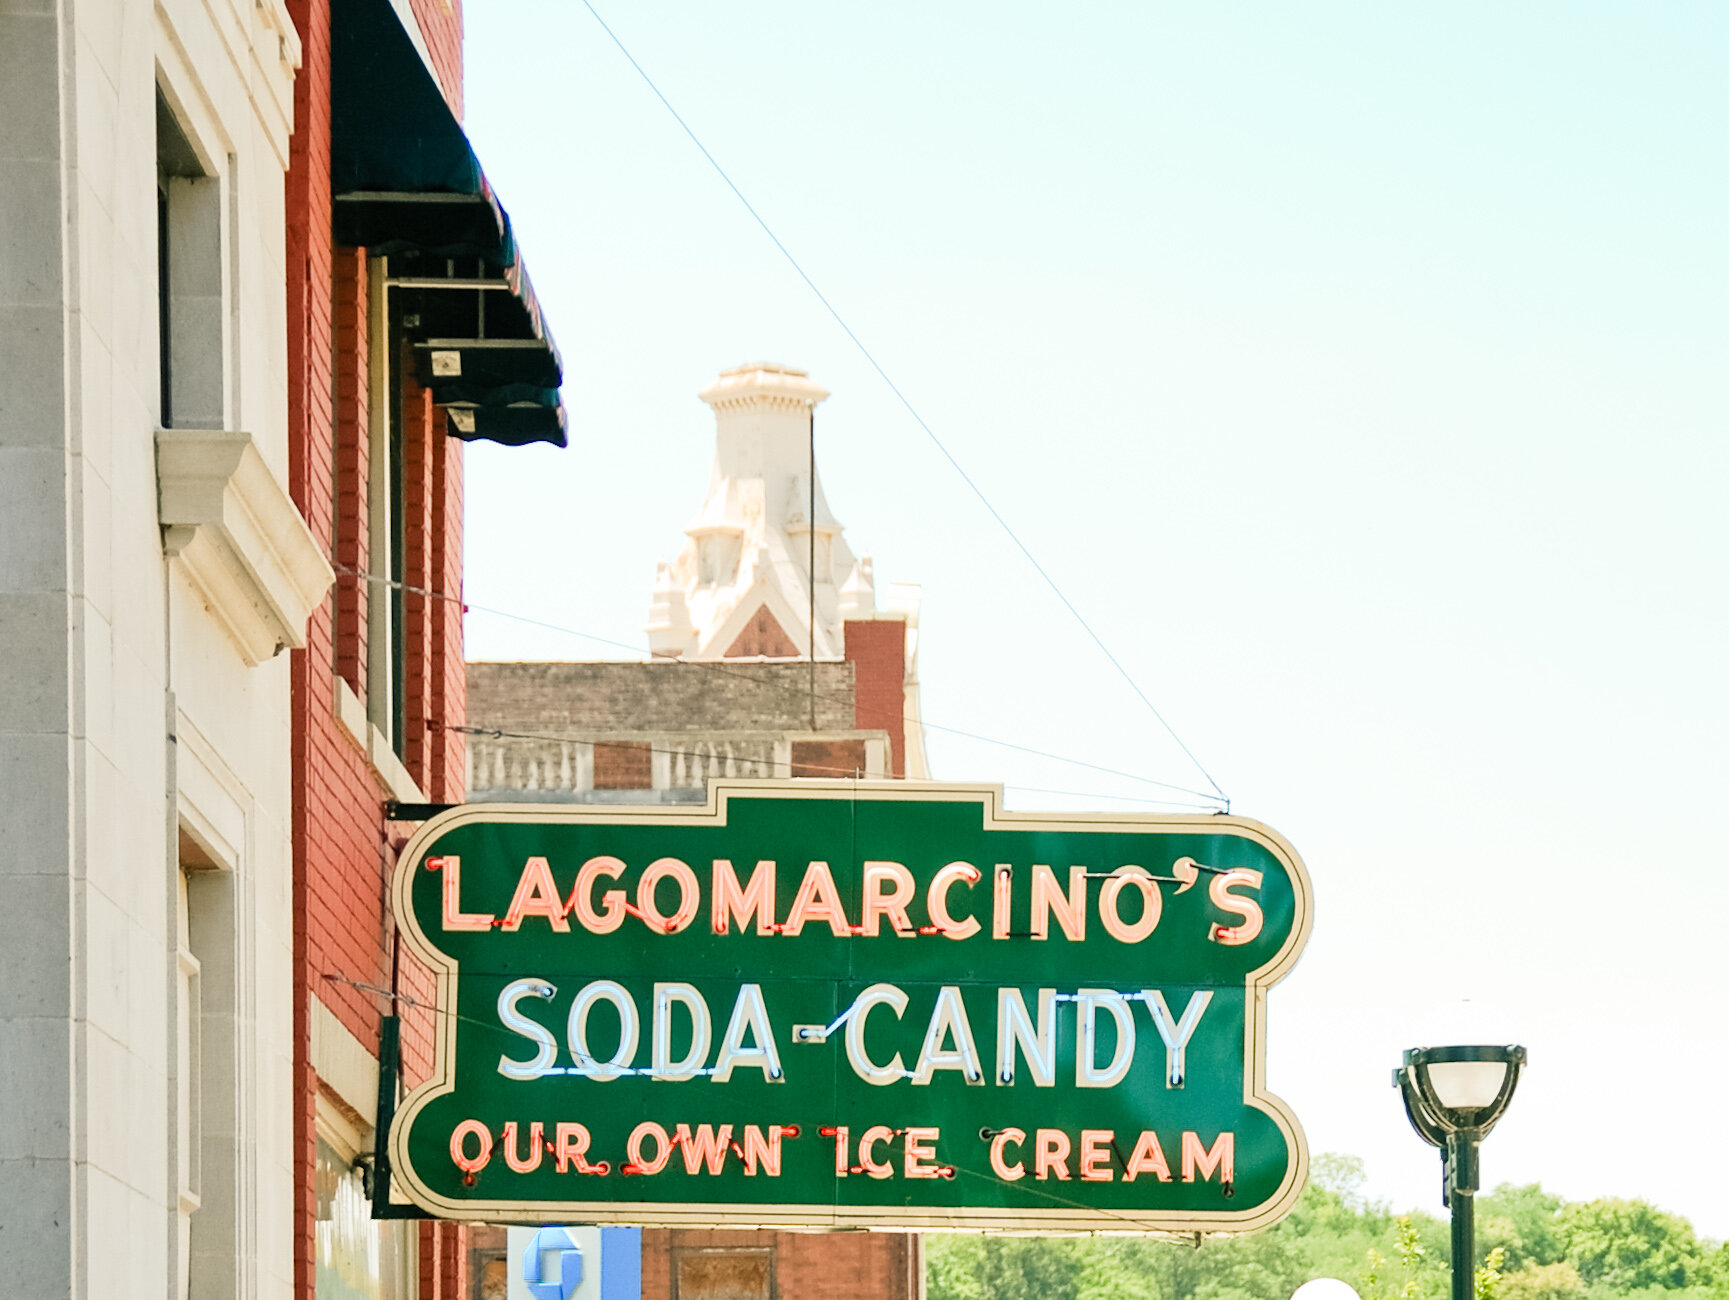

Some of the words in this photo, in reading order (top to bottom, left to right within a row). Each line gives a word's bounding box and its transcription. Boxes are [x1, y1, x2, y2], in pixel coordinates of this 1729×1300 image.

[441, 856, 1265, 946] LAGOMARCINO'S
[497, 977, 1215, 1090] SODA-CANDY
[449, 1118, 598, 1175] OUR
[626, 1120, 783, 1177] OWN
[834, 1125, 940, 1180] ICE
[988, 1126, 1235, 1183] CREAM
